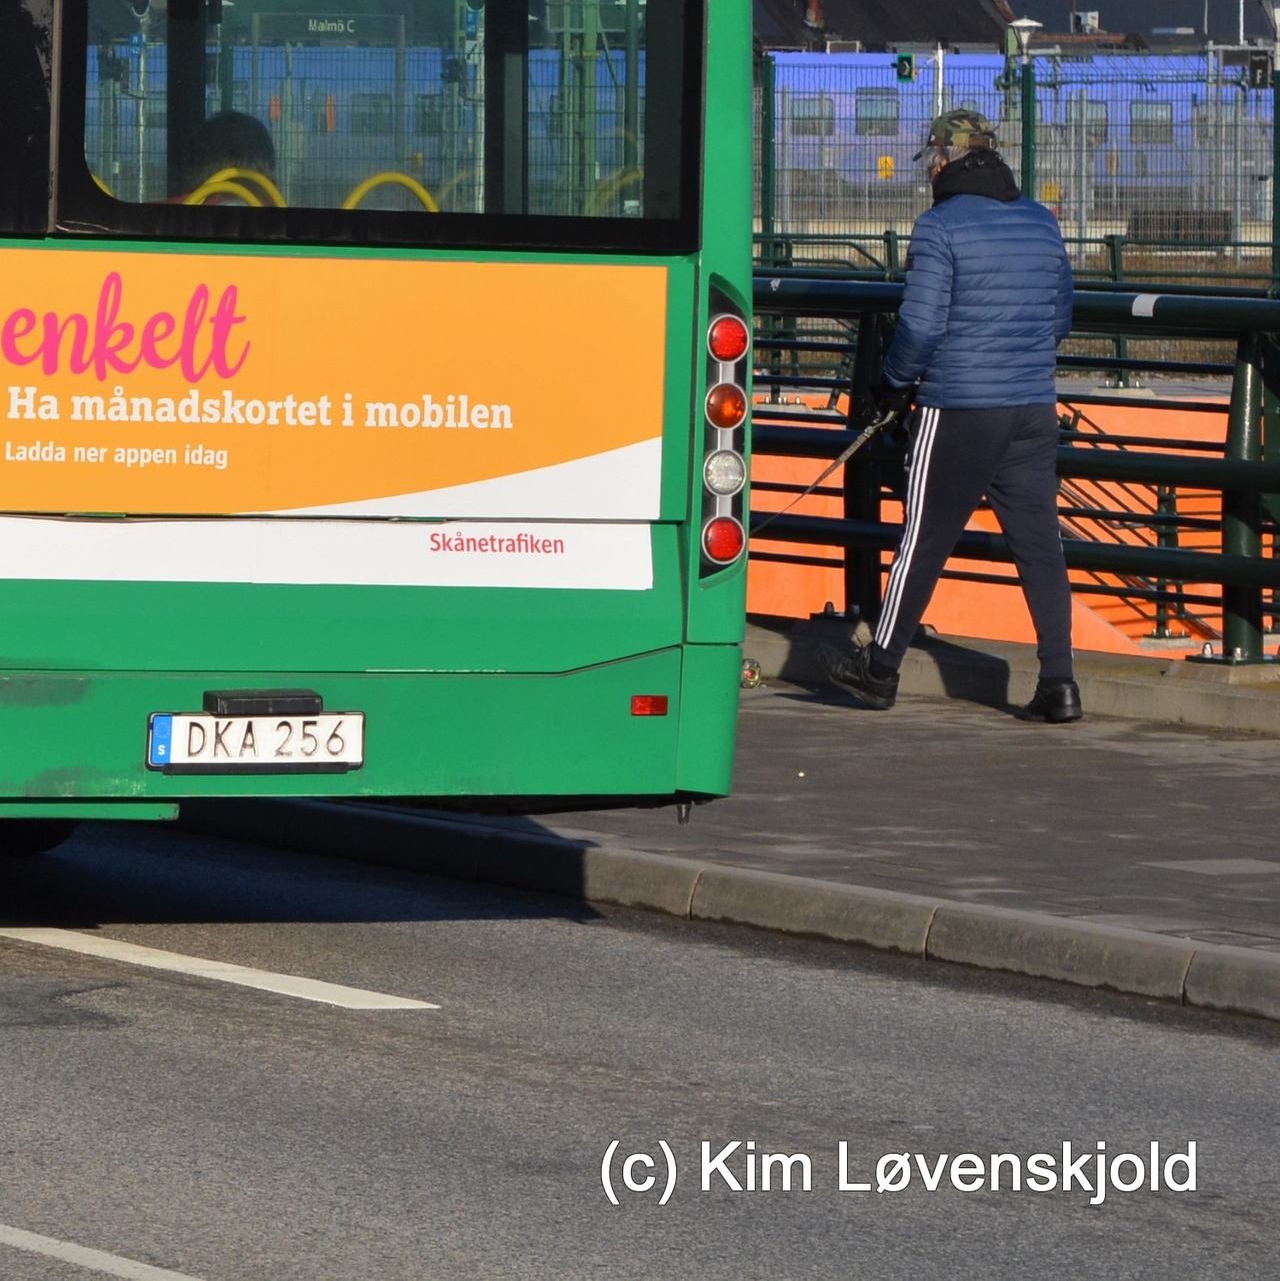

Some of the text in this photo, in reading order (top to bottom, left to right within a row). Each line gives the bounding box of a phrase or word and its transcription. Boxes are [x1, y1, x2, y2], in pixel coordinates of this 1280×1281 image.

[308, 19, 355, 33] Malmö C
[1, 271, 251, 383] enkelt
[7, 386, 513, 429] Ha månadskortet i mobilen
[5, 441, 228, 469] Ladda ner appen idag
[429, 532, 565, 554] Skånetrafiken
[158, 745, 166, 756] S
[187, 721, 345, 757] DKA 256
